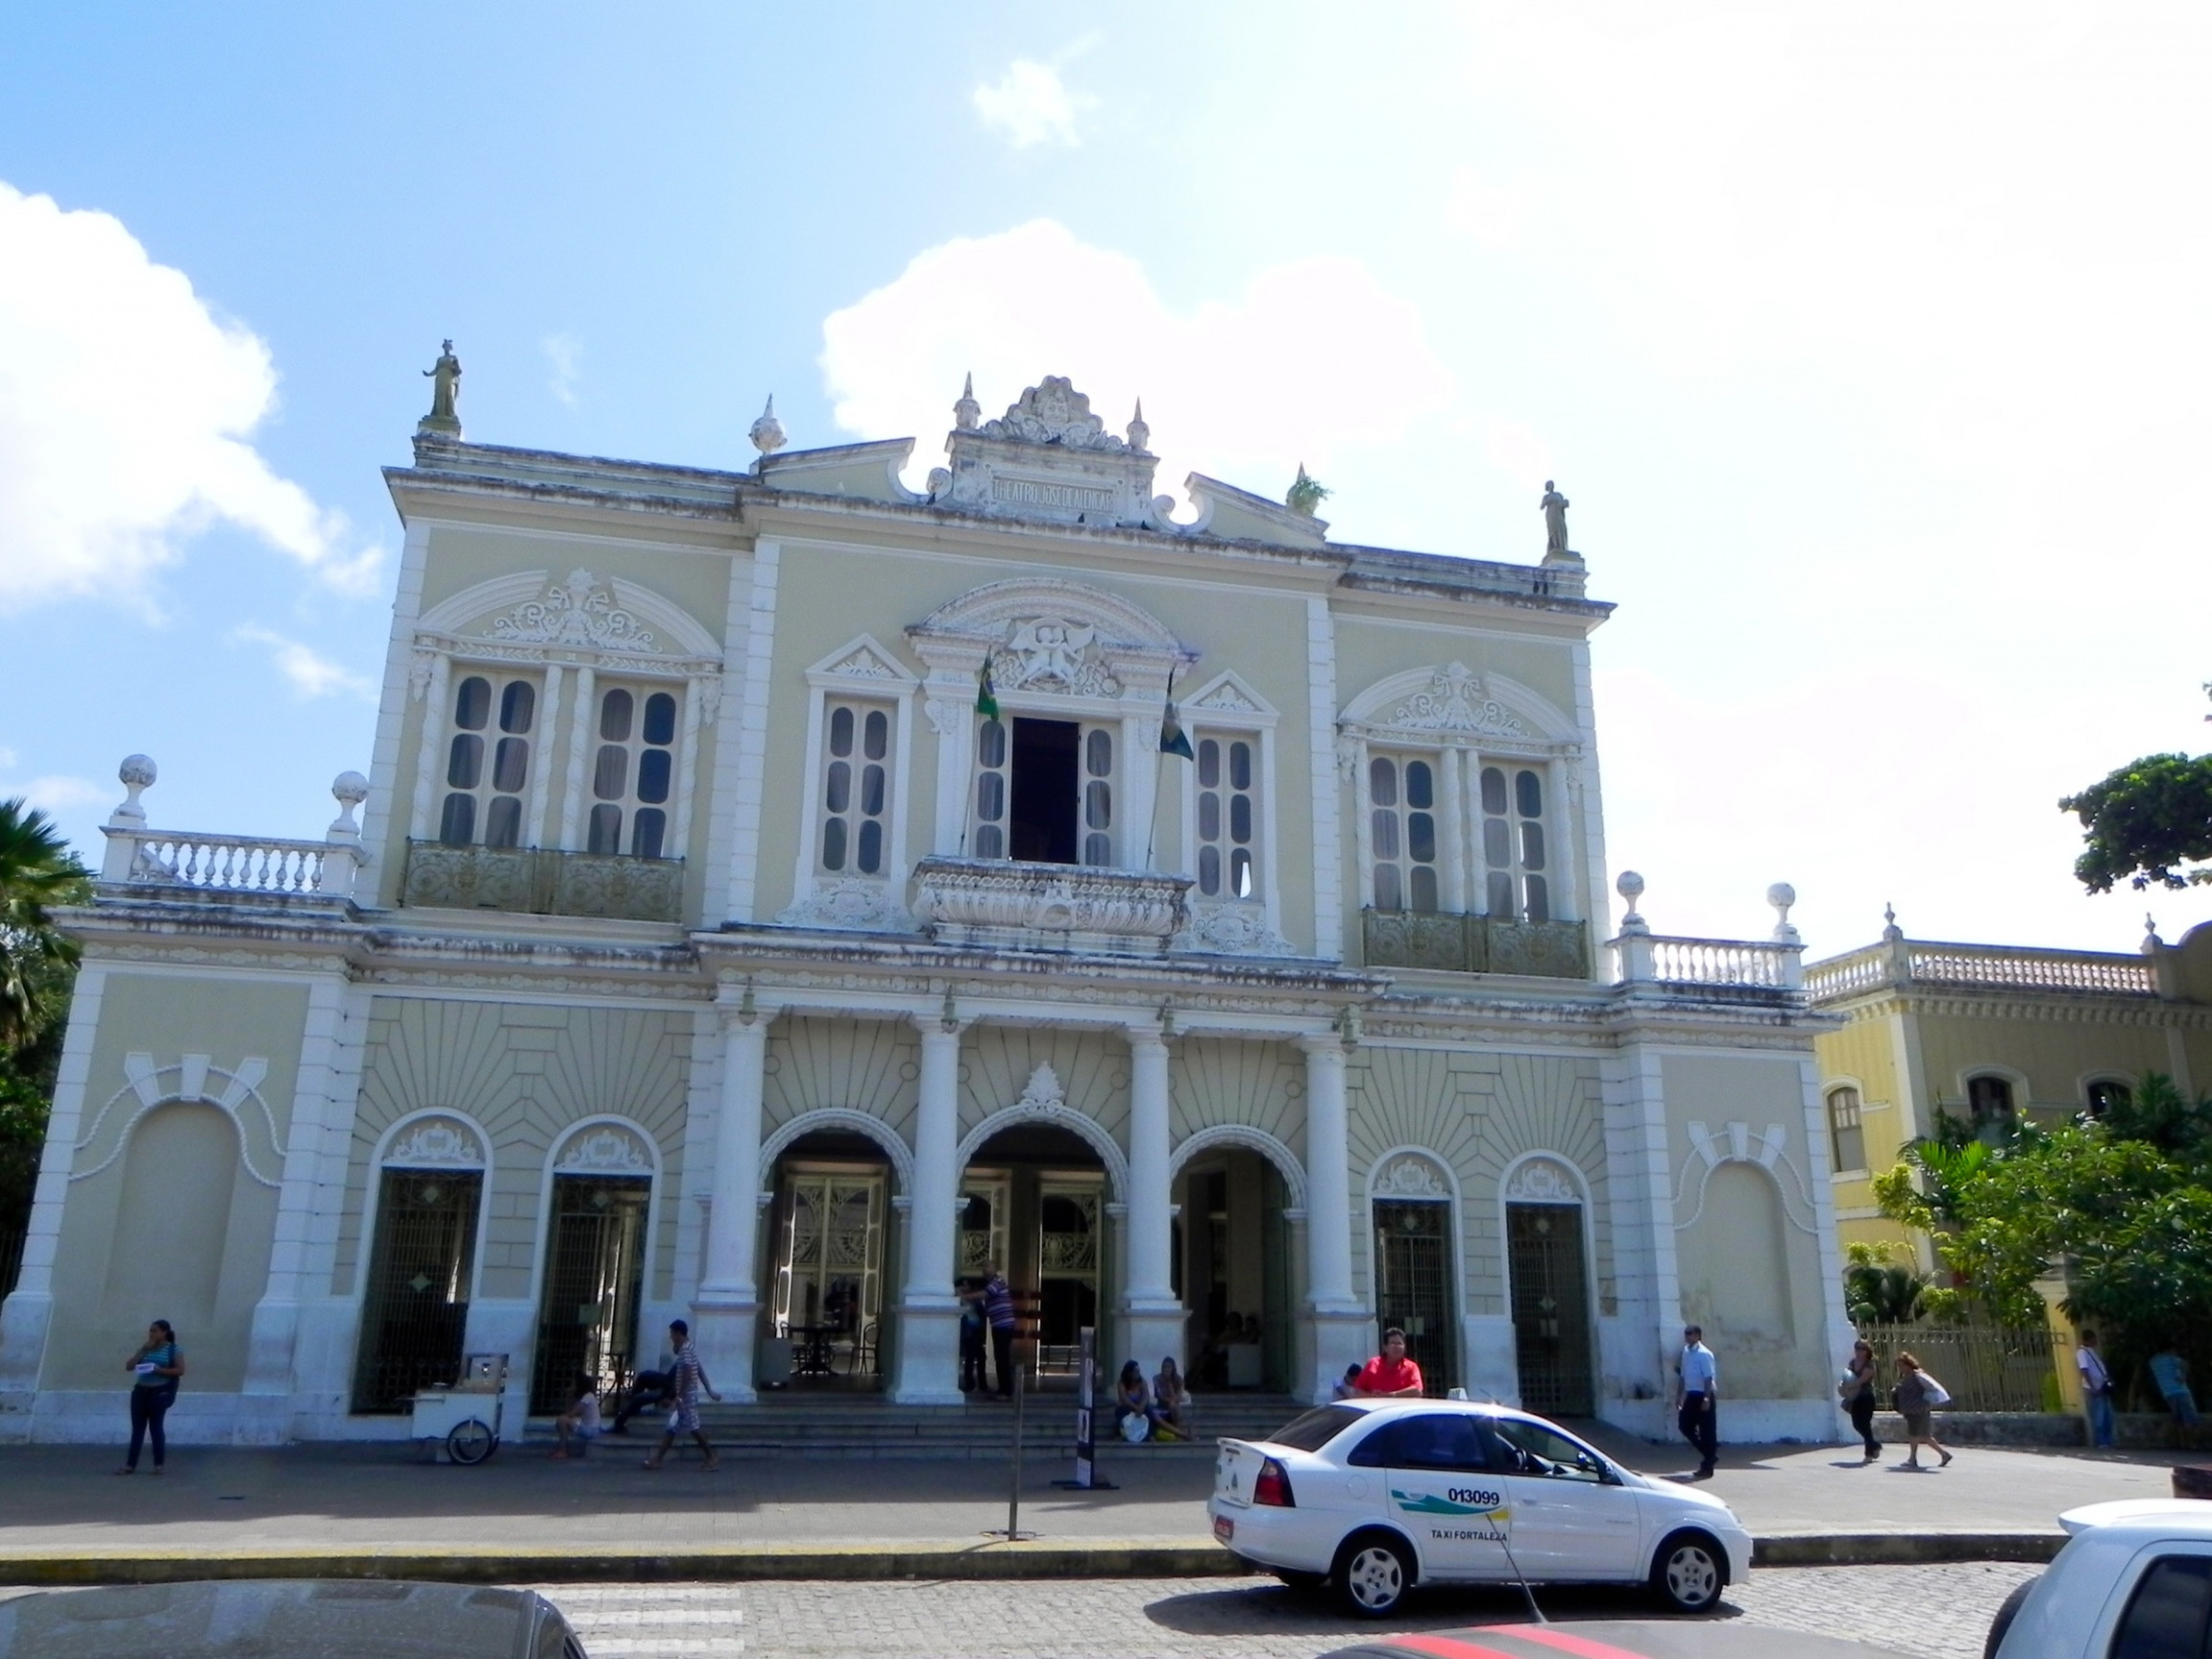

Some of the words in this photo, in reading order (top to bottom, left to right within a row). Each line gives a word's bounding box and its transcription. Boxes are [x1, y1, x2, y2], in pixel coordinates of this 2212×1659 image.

[992, 480, 1038, 504] THEATRO
[1062, 487, 1073, 508] DE
[1074, 489, 1112, 511] ALENCAR
[1448, 1488, 1500, 1506] 013099
[1431, 1530, 1452, 1539] TAXI
[1454, 1531, 1507, 1541] FORTALEZA
